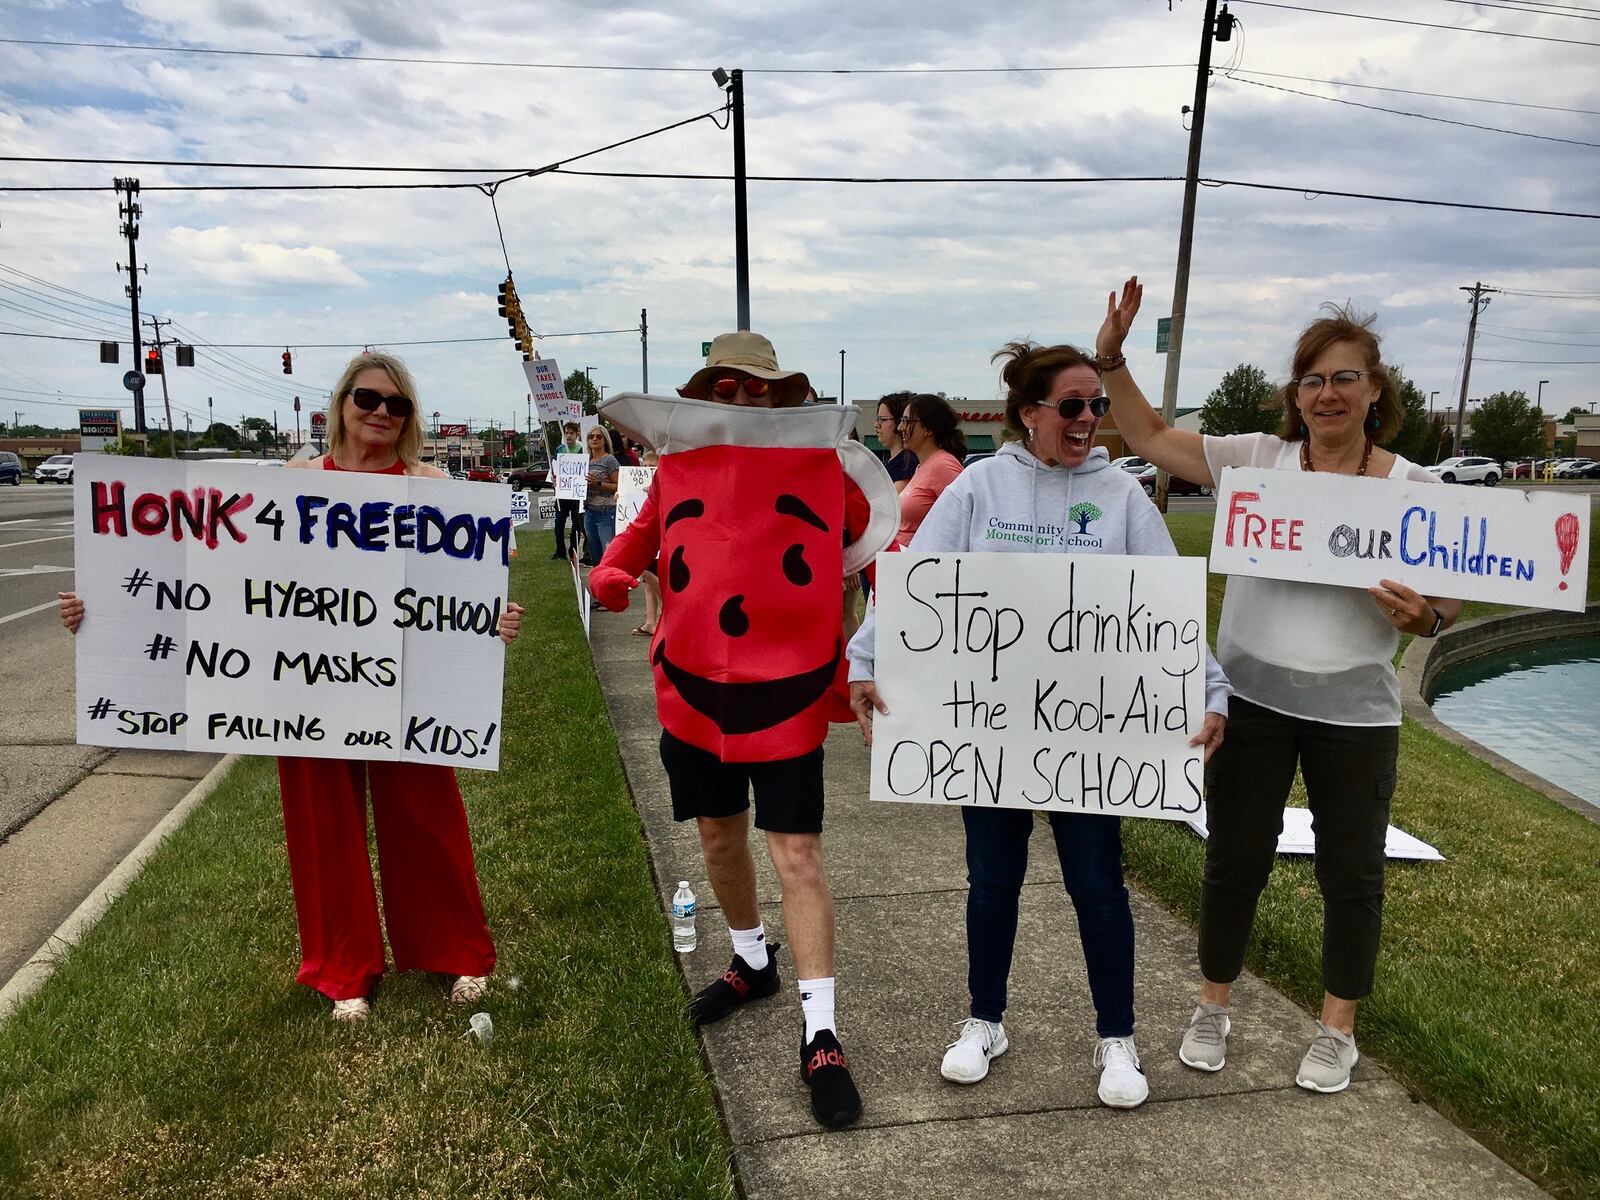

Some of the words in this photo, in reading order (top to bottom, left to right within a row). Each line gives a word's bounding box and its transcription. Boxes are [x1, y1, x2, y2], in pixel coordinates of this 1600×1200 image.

[536, 373, 557, 382] TAXES
[536, 391, 564, 401] SCHOOLS
[956, 411, 1005, 422] reen
[559, 460, 587, 476] FREEDOM
[91, 480, 254, 550] HONK
[256, 500, 285, 541] 4
[296, 494, 511, 566] FREEDOM
[245, 578, 377, 627] HYBRID
[393, 587, 500, 637] SCHOOL
[900, 558, 1024, 682] Stop
[1047, 562, 1200, 676] drinking
[273, 650, 397, 687] MASKS
[943, 680, 1008, 730] the
[1033, 669, 1189, 735] Kool-Aid
[208, 712, 326, 742] FAILING
[404, 715, 497, 758] KIDS!
[887, 740, 1003, 804] OPEN
[1022, 747, 1202, 814] SCHOOLS
